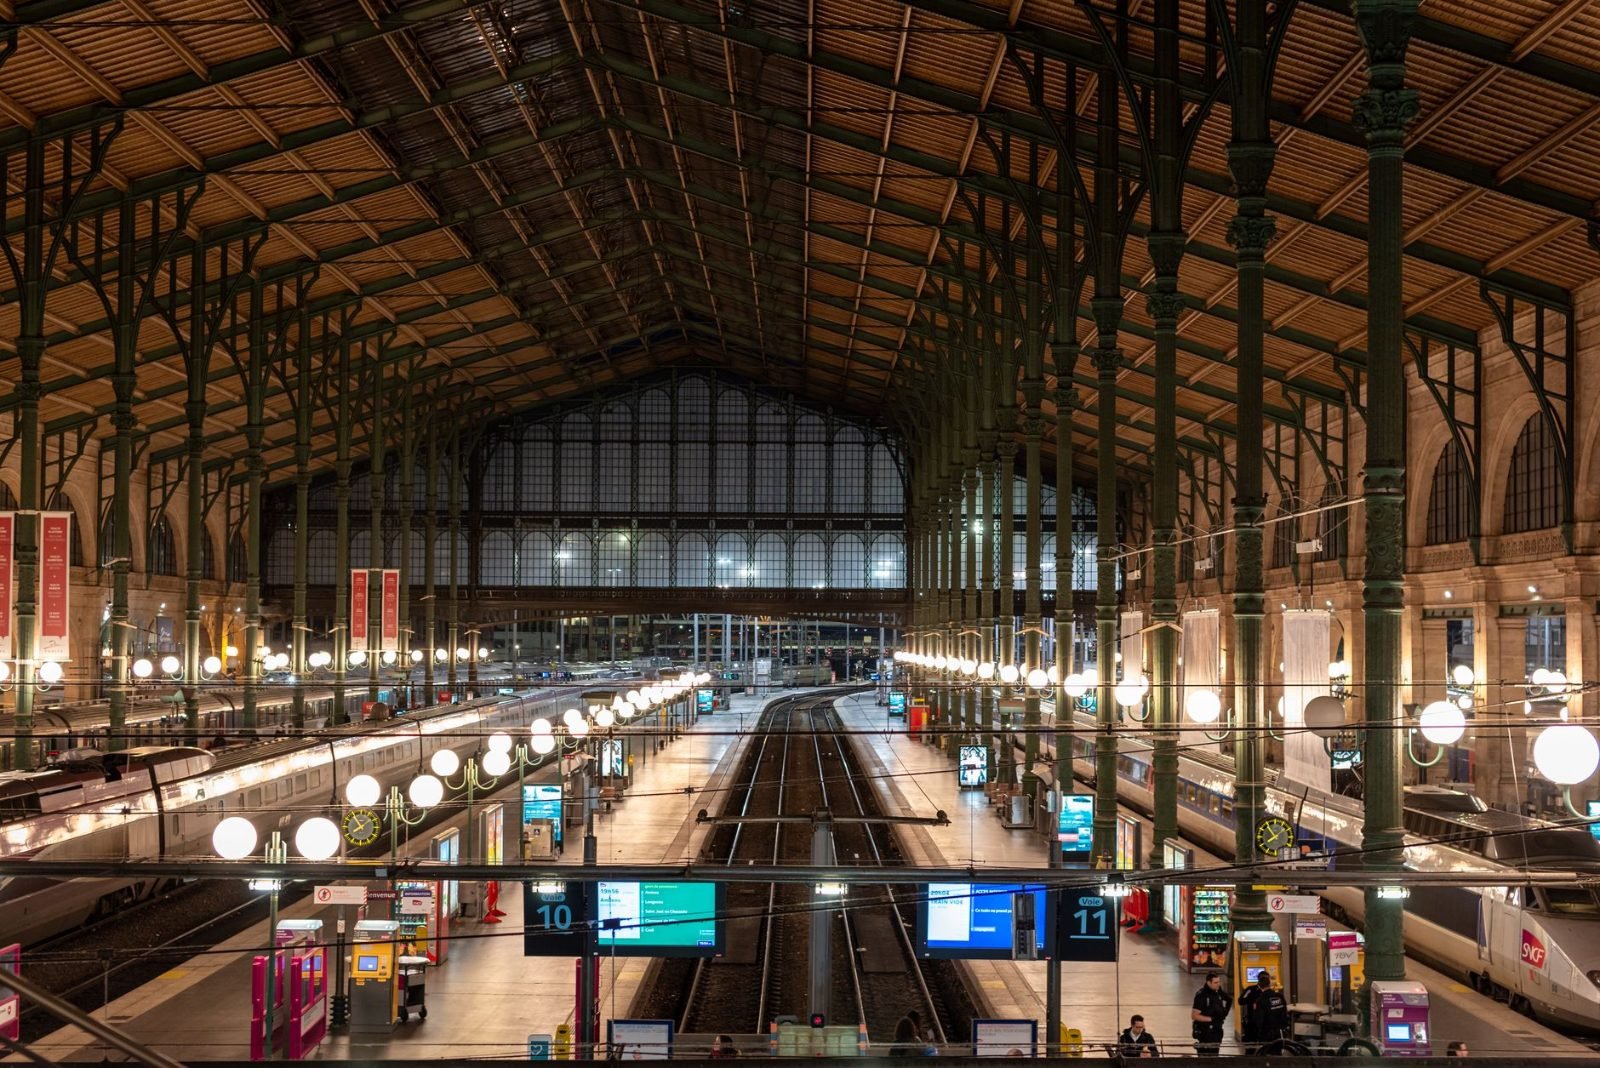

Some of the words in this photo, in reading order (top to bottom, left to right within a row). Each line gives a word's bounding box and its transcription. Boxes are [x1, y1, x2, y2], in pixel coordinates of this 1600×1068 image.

[537, 905, 572, 930] 10
[1074, 909, 1106, 934] 11
[1522, 943, 1545, 963] SNCF
